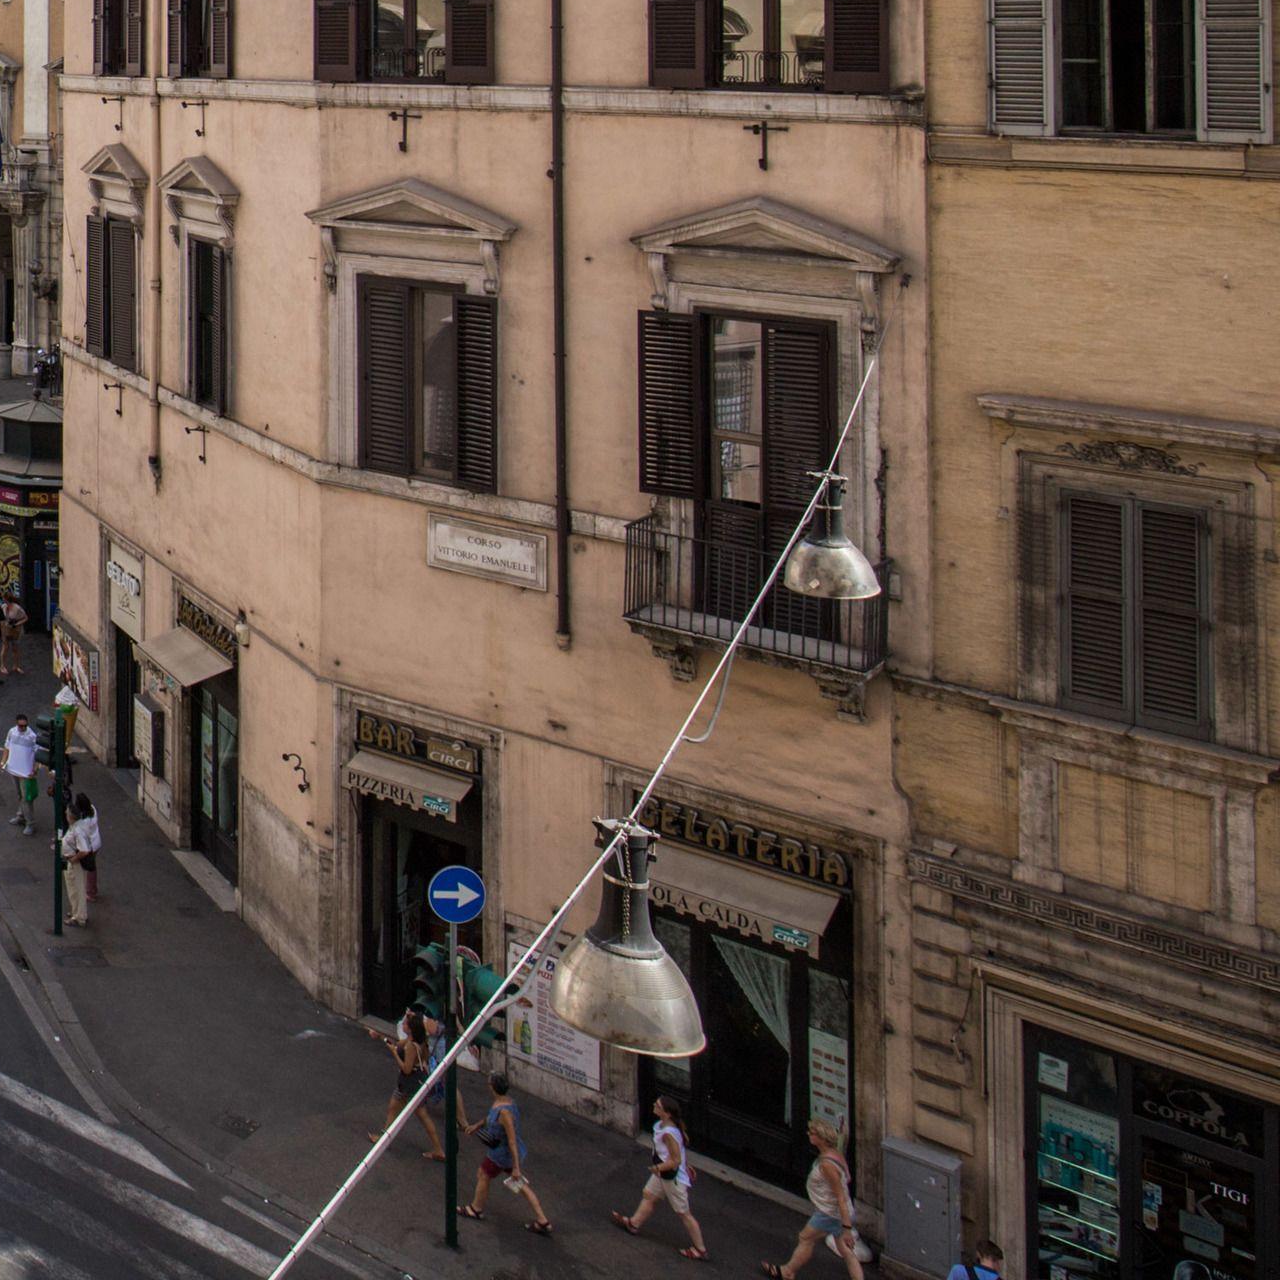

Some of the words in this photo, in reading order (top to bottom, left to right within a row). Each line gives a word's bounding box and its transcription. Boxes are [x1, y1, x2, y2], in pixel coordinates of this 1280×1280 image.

[437, 545, 478, 561] VITTORIO
[481, 554, 529, 572] EMANUELE
[466, 535, 502, 550] CORSO
[359, 716, 416, 755] BAR
[429, 751, 472, 770] CIRCI
[348, 771, 415, 804] PIZZERIA
[423, 800, 449, 813] CIRCI
[641, 796, 849, 886] GELATERIA
[651, 886, 689, 910] OLA
[699, 901, 762, 935] CALDA
[1143, 1100, 1249, 1147] COPPOLA
[1210, 1182, 1250, 1205] TIGI
